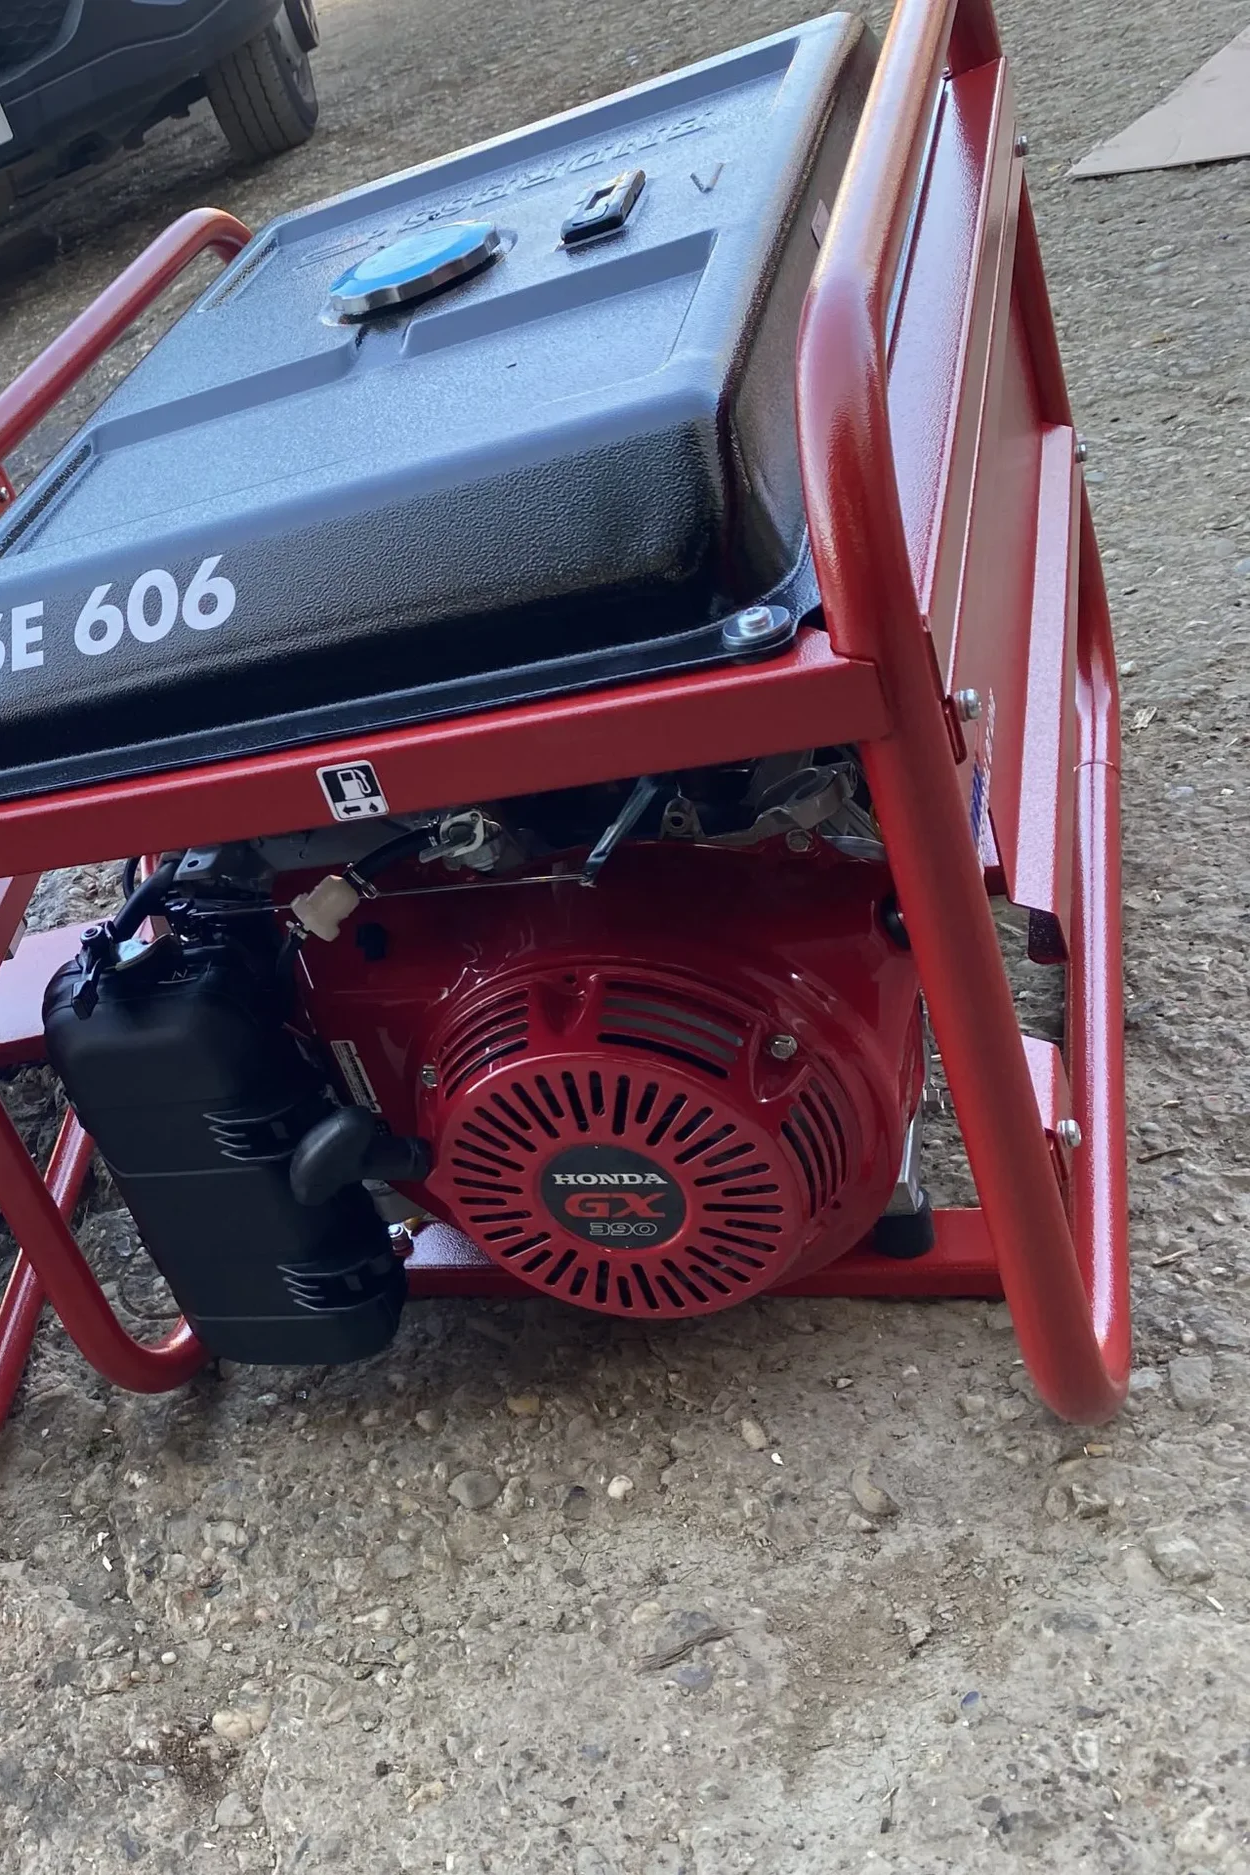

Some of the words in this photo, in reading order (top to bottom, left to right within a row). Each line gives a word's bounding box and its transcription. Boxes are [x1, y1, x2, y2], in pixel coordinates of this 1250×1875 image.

[74, 554, 236, 656] 606
[552, 1173, 669, 1186] HONDA
[564, 1192, 666, 1219] GX
[589, 1222, 658, 1237] 390
